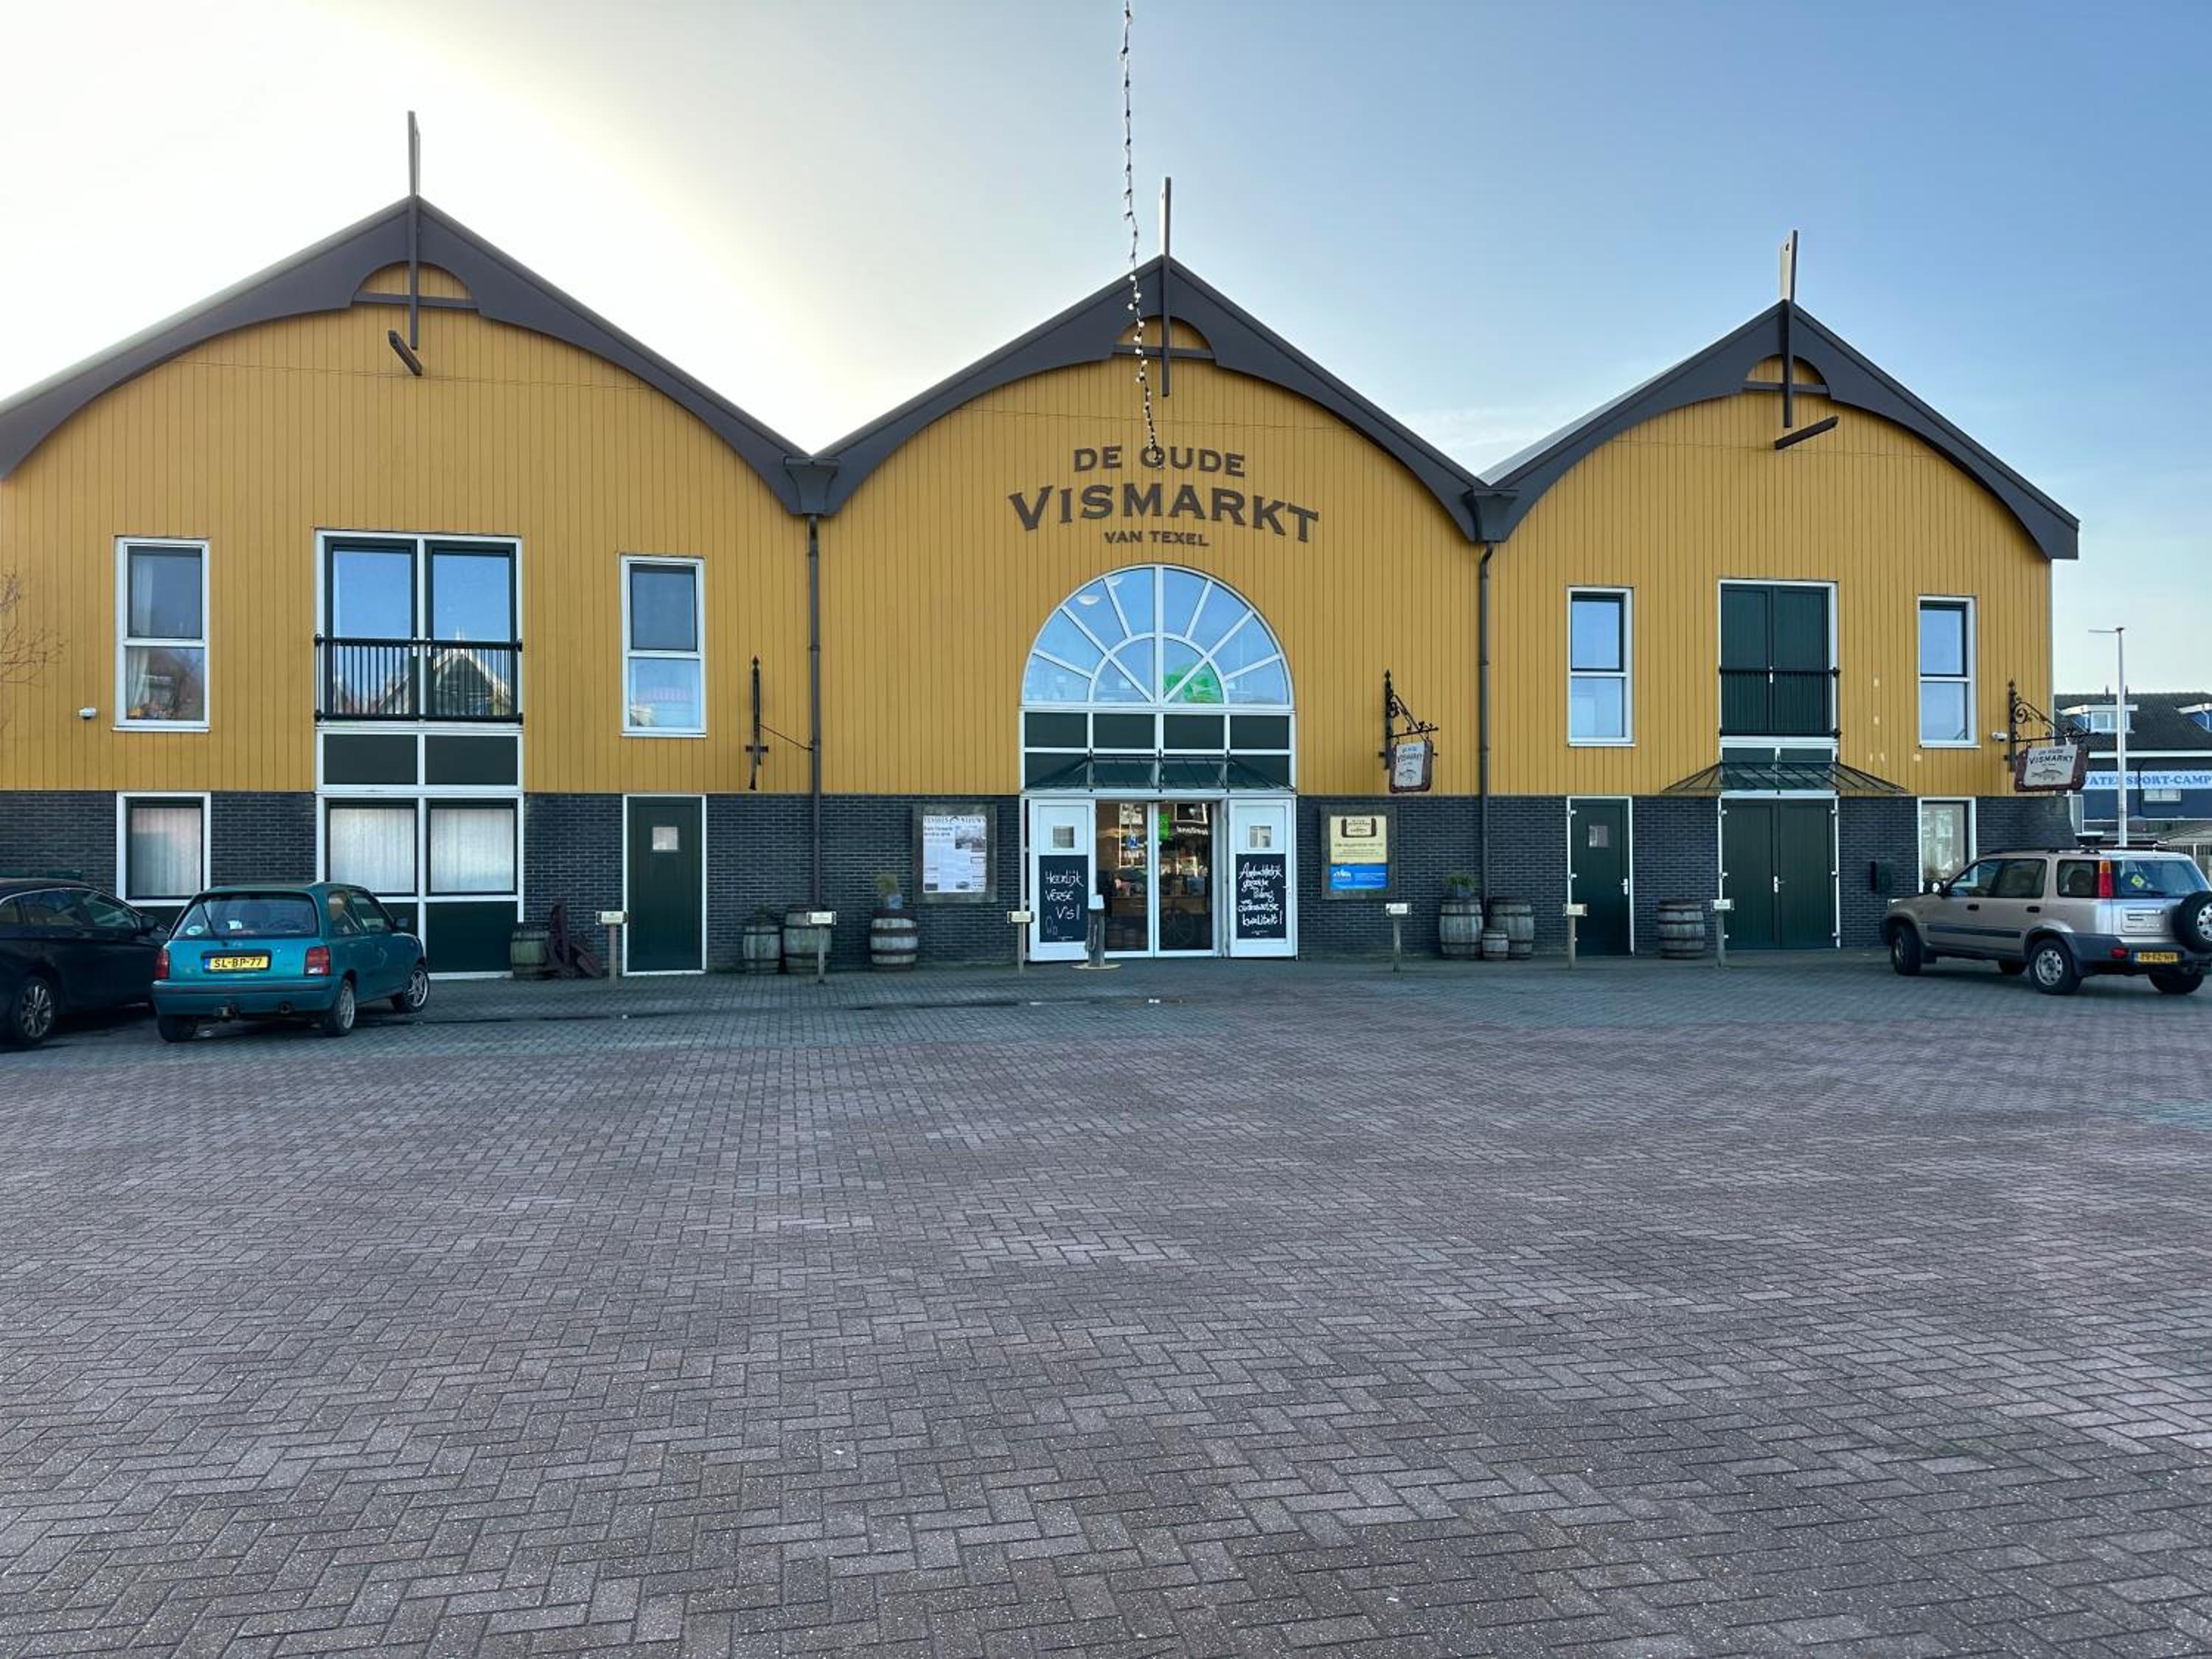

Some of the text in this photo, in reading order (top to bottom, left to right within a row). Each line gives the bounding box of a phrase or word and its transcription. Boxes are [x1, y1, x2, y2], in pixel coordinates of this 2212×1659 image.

[1074, 445, 1245, 477] DE OUDE
[1008, 483, 1319, 543] VISMARKT
[1104, 530, 1210, 546] VAN TEXEL
[2028, 754, 2073, 765] VISMARKT
[214, 958, 262, 968] SL-BP-77
